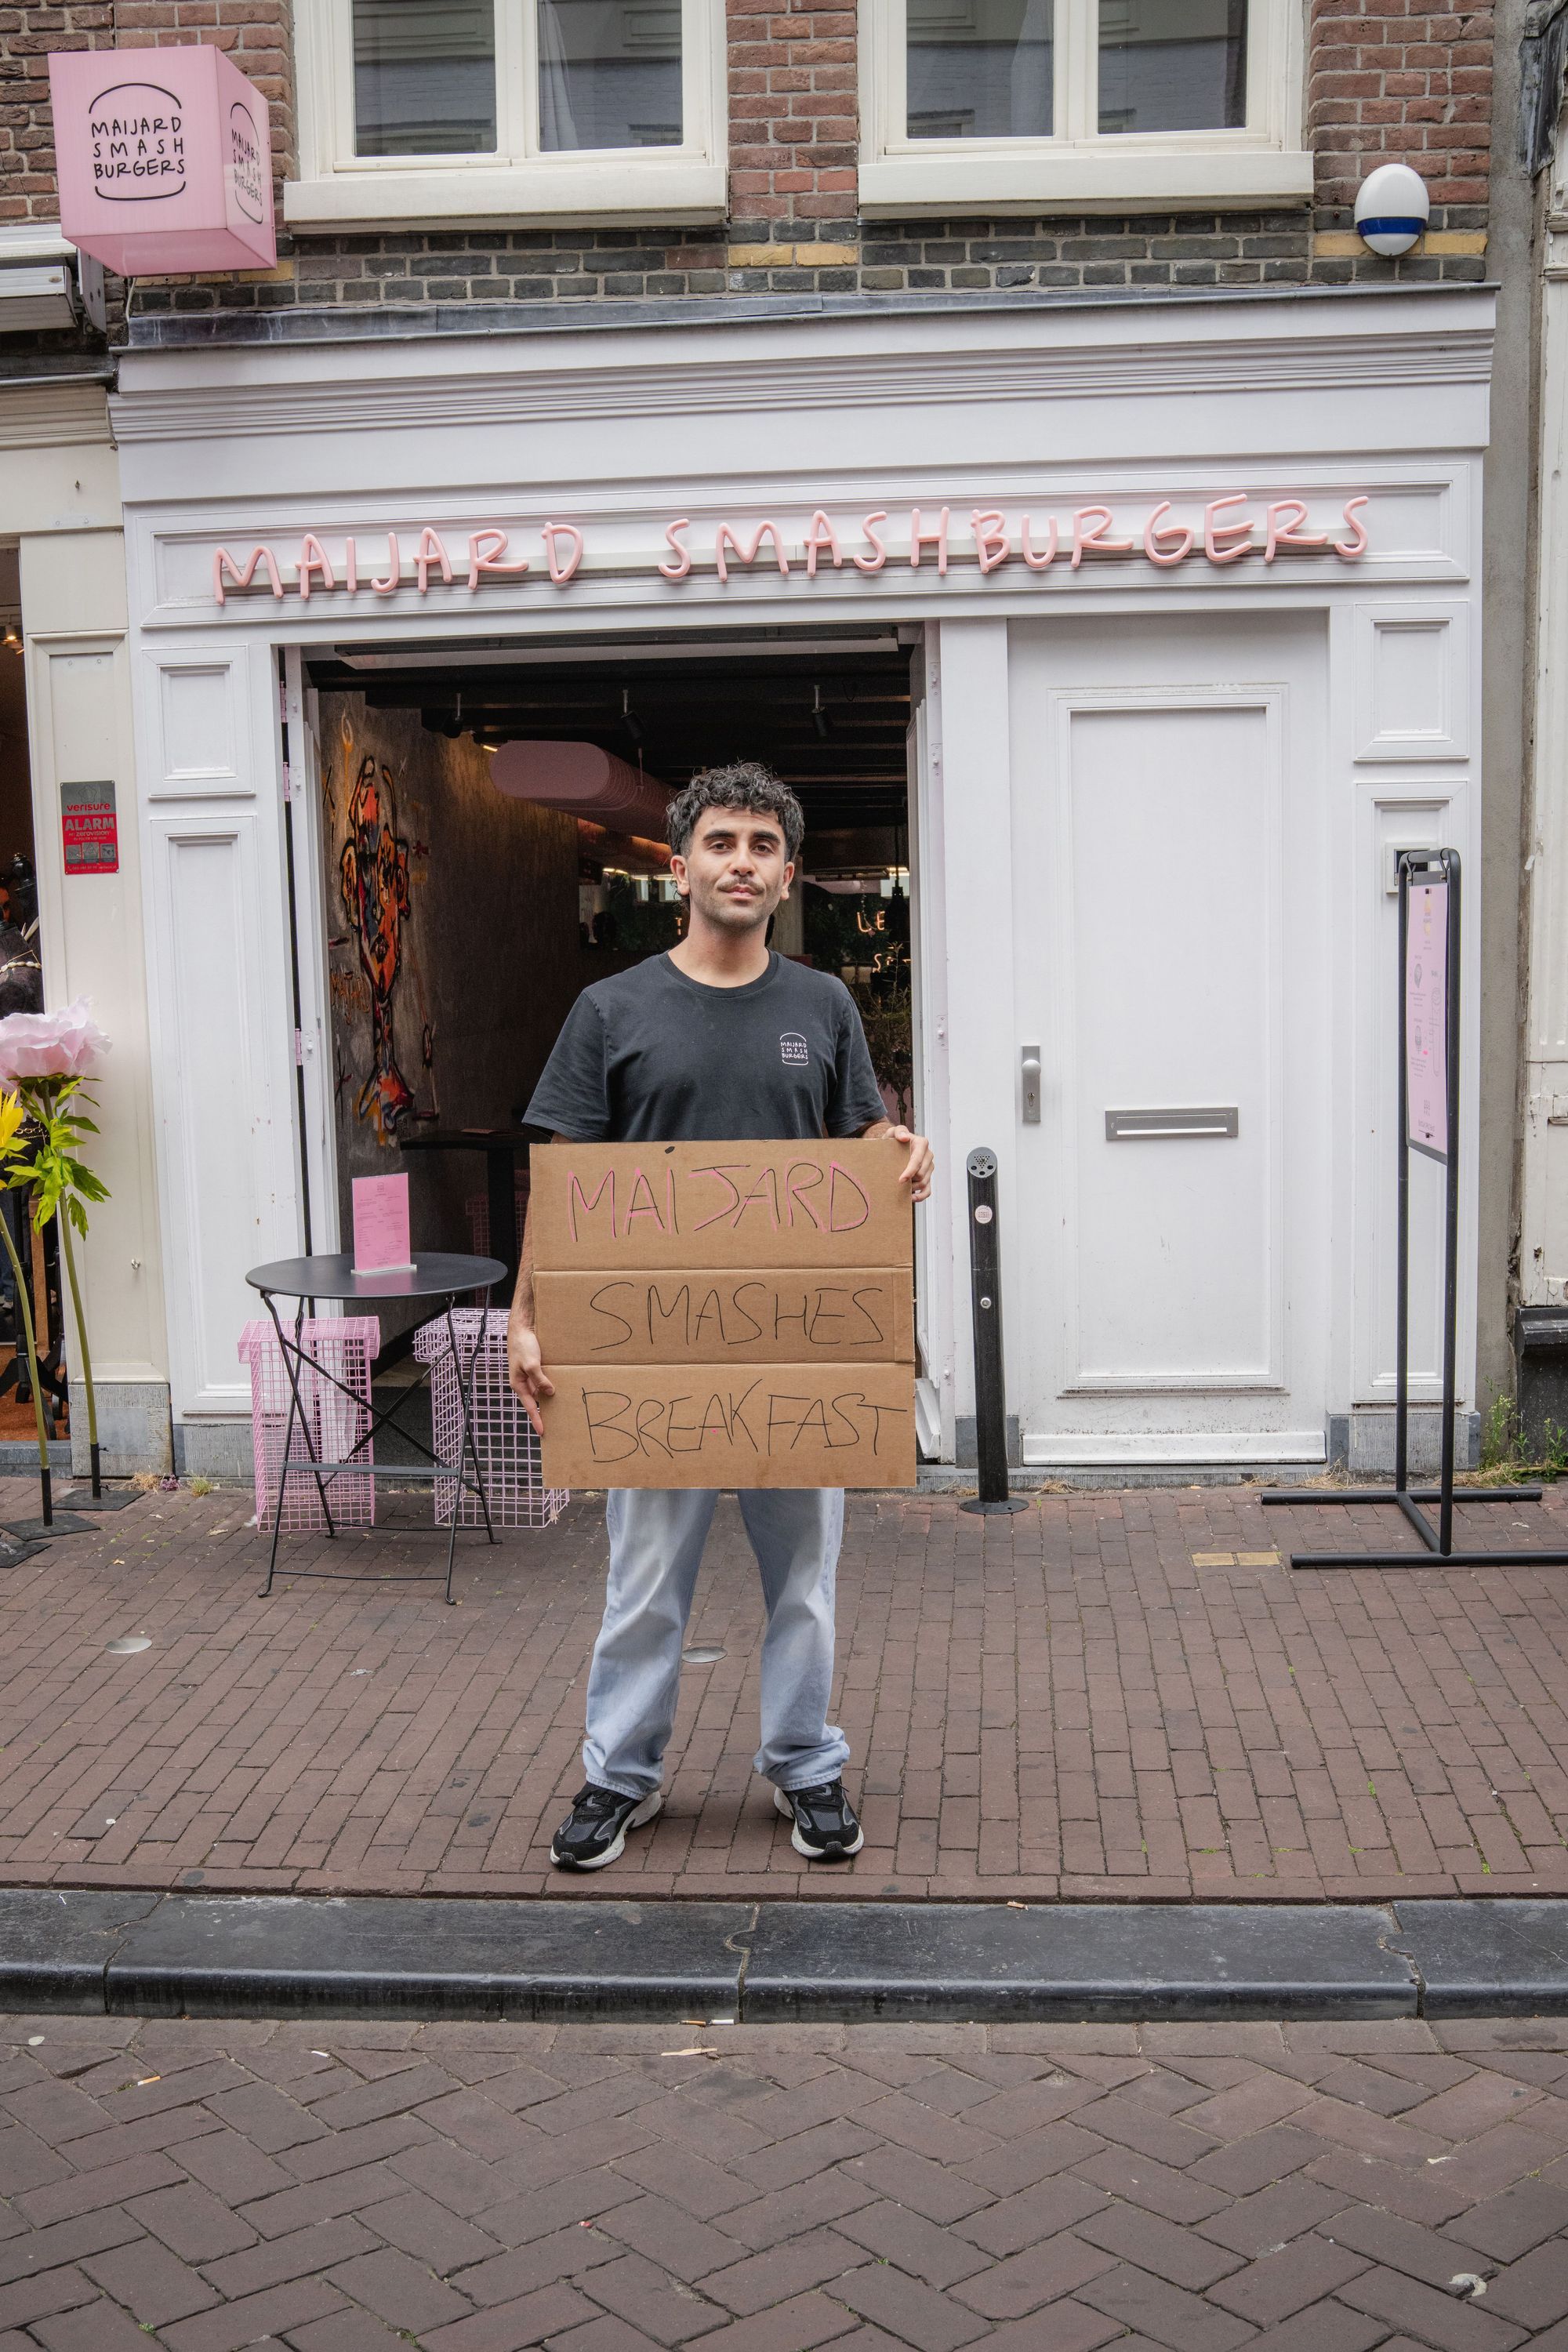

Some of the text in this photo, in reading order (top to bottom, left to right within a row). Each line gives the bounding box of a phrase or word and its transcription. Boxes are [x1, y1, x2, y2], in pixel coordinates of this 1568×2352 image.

[92, 116, 181, 138] MAIJARD
[93, 137, 183, 158] SMASH
[231, 129, 260, 166] MAIJARD
[94, 158, 184, 179] BURGERS
[233, 149, 262, 188] SMASH
[234, 169, 263, 207] BURGERS
[213, 521, 583, 604] MAIJARD
[65, 817, 115, 831] ALARM
[66, 802, 111, 811] verisure
[568, 1156, 870, 1242] MAIJARD
[590, 1282, 884, 1351] SMASHES
[582, 1378, 908, 1463] BREAKFAST
